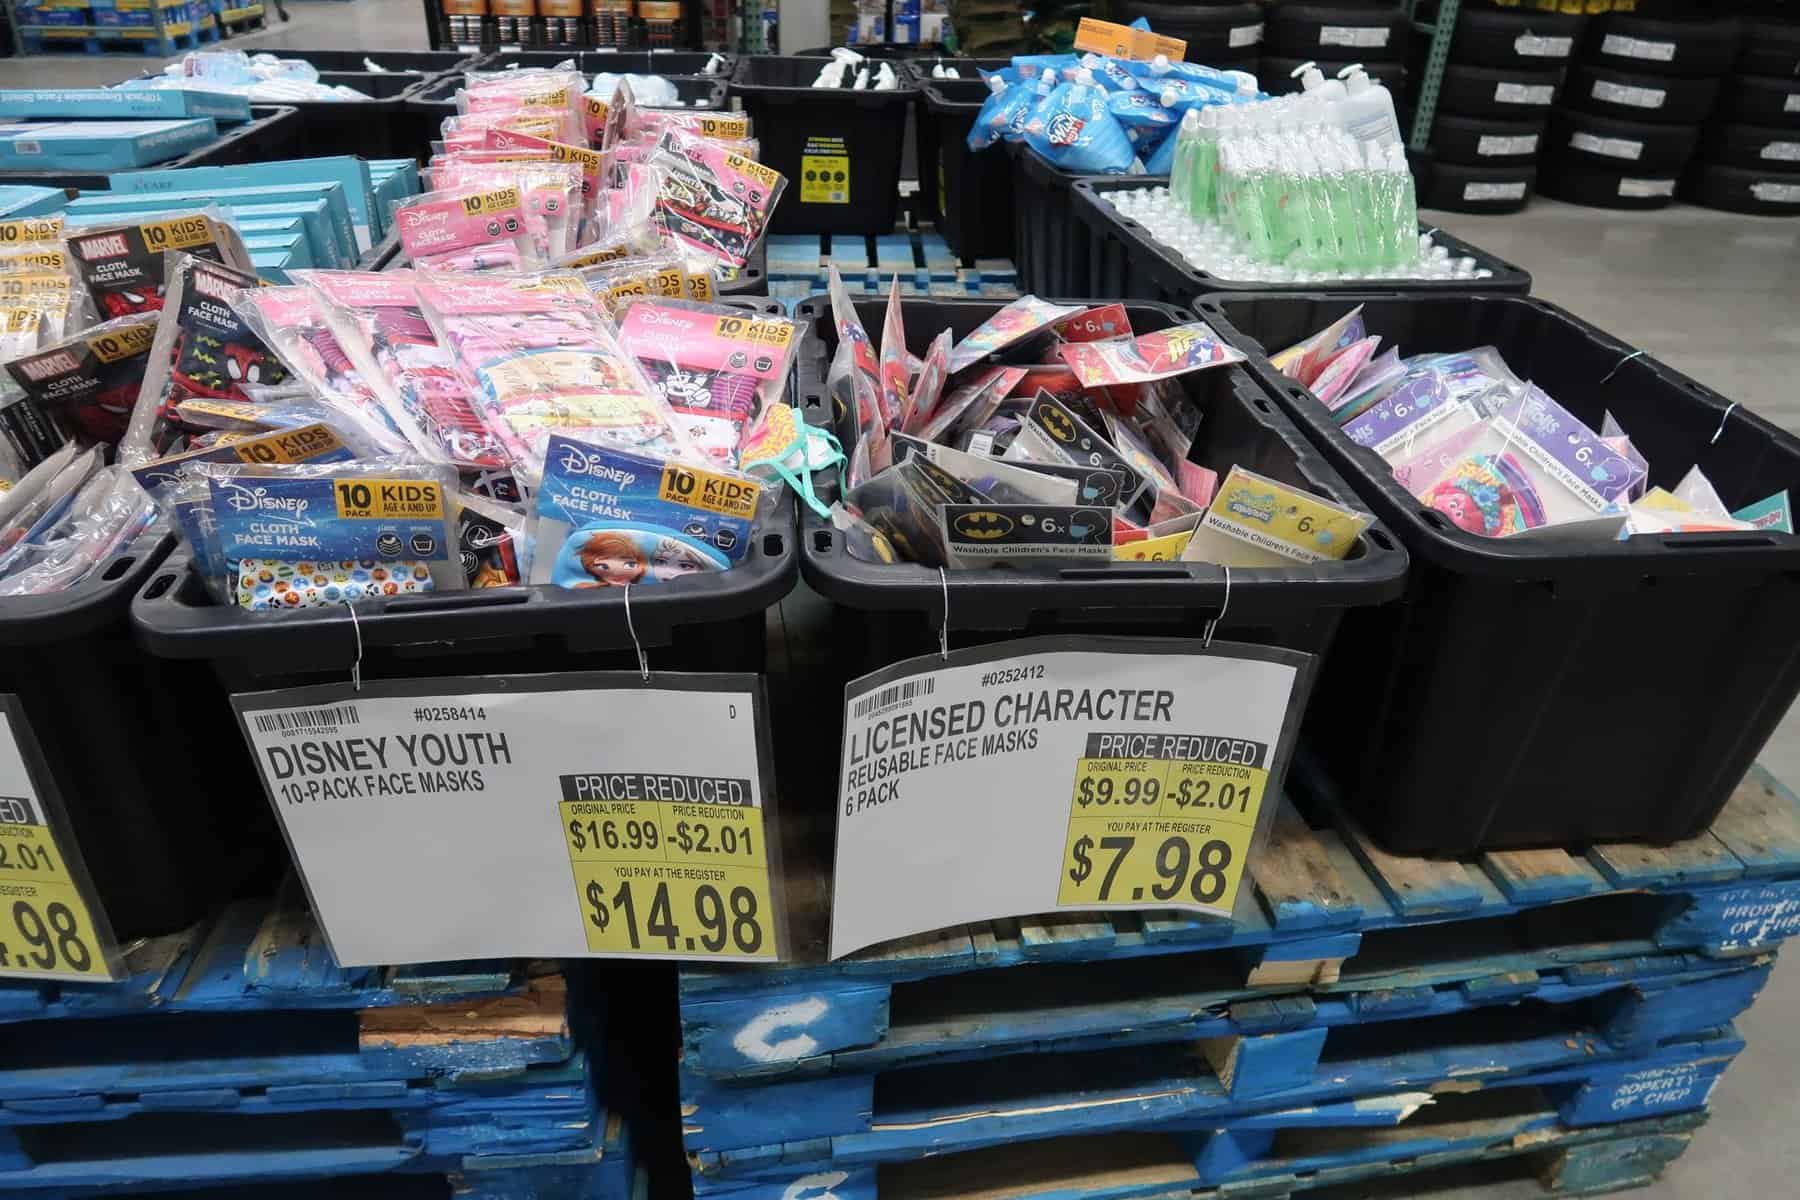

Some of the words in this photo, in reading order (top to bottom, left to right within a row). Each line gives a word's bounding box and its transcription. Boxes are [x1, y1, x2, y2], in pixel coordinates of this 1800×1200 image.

[701, 120, 716, 132] 10
[720, 121, 745, 131] KIDS
[570, 151, 599, 164] KIDS
[464, 196, 481, 211] 10
[485, 189, 515, 202] KIDS
[24, 222, 59, 234] KIDS
[144, 227, 166, 245] 10
[170, 220, 207, 235] KIDS
[79, 235, 128, 260] MARVEL
[24, 254, 60, 266] KIDS
[96, 262, 128, 273] CLOTH
[90, 271, 113, 283] FACE
[115, 267, 143, 280] MASK
[188, 306, 216, 323] FACE
[214, 314, 240, 331] MASK
[200, 301, 230, 318] CLOTH
[719, 318, 742, 333] 10
[748, 323, 789, 337] KIDS
[93, 338, 118, 357] 10
[20, 353, 80, 380] MARVEL
[47, 374, 84, 391] CLOTH
[1394, 403, 1414, 418] 6x
[241, 444, 276, 465] 10
[276, 425, 330, 451] KIDS
[1575, 446, 1594, 468] 6x
[667, 468, 694, 493] 10
[704, 479, 755, 502] KIDS
[339, 484, 372, 509] 10
[381, 485, 437, 502] KIDS
[571, 486, 618, 506] CLOTH
[665, 491, 690, 504] PACK
[345, 509, 372, 518] PACK
[383, 503, 398, 513] AGE
[407, 503, 423, 512] AND
[425, 503, 437, 512] UP
[552, 495, 588, 513] FACE
[591, 502, 633, 521] MASK
[250, 523, 299, 534] CLOTH
[1041, 518, 1065, 535] 6x
[1208, 515, 1249, 538] Washable
[1250, 533, 1290, 553] Children's
[1297, 516, 1316, 535] 6x
[235, 534, 273, 545] FACE
[276, 535, 318, 546] MASK
[953, 545, 999, 555] Washable
[1002, 545, 1051, 555] Children's
[1053, 546, 1075, 555] Face
[1078, 546, 1109, 555] Masks
[982, 664, 1045, 687] #0252412
[413, 706, 487, 722] #0258414
[728, 704, 737, 719] D
[849, 699, 986, 766] LICENSED
[994, 689, 1175, 728] CHARACTER
[266, 736, 388, 780] DISNEY
[396, 732, 512, 767] YOUTH
[1098, 734, 1158, 758] PRICE
[1161, 736, 1257, 765] REDUCED
[847, 746, 930, 793] REUSABLE
[934, 737, 978, 766] FACE
[981, 728, 1039, 757] MASKS
[1087, 761, 1123, 772] ORIGINAL
[1124, 761, 1148, 772] PRICE
[1182, 763, 1206, 775] PRICE
[1206, 765, 1251, 780] REDUCTION
[281, 773, 363, 806] 10-PACK
[365, 772, 417, 797] FACE
[418, 769, 485, 793] MASKS
[575, 775, 640, 802] PRICE
[644, 776, 743, 805] REDUCED
[1077, 776, 1161, 808] $9.99
[1166, 778, 1252, 813] -$2.01
[845, 797, 854, 818] 6
[857, 779, 901, 814] PACK
[571, 803, 609, 815] ORIGINAL
[611, 803, 636, 814] PRICE
[672, 805, 697, 818] PRICE
[698, 806, 745, 820] REDUCTION
[569, 819, 659, 853] $16.99
[667, 821, 753, 855] -$2.01
[1107, 822, 1124, 833] YOU
[1124, 822, 1140, 833] PAY
[1141, 822, 1154, 833] AT
[1154, 822, 1171, 833] THE
[1171, 822, 1212, 834] REGISTER
[614, 867, 633, 878] YOU
[634, 867, 651, 878] PAY
[651, 867, 665, 879] AT
[666, 868, 683, 879] THE
[684, 868, 727, 881] REGISTER
[1070, 834, 1232, 904] $7.98
[586, 880, 763, 954] $14.98
